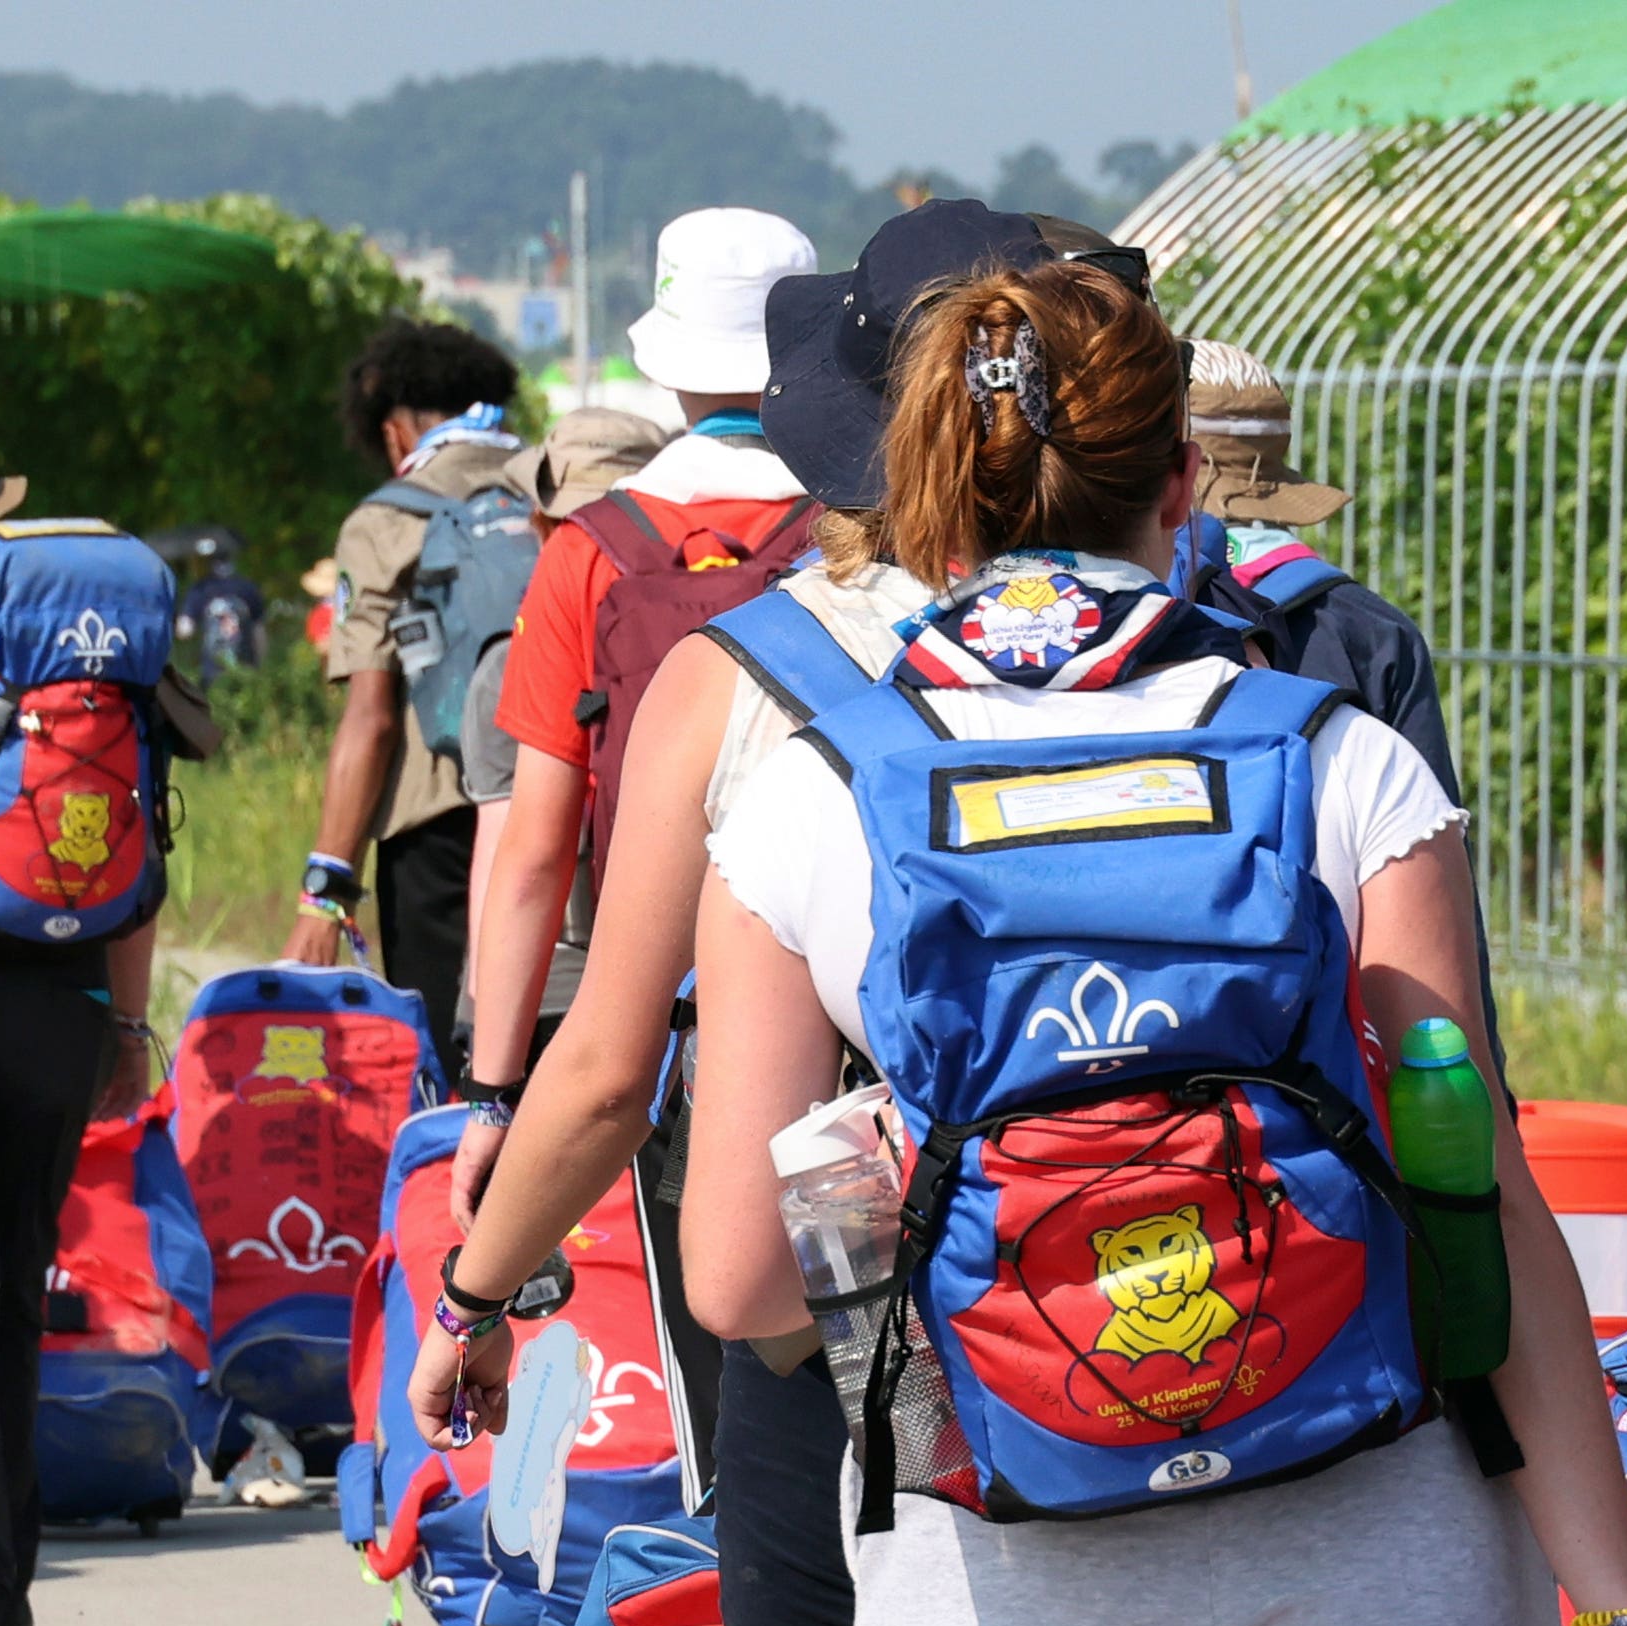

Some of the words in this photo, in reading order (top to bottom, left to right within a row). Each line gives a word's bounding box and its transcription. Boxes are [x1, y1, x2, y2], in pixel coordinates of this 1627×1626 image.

[1152, 1379, 1222, 1404] Kingdom
[1116, 1414, 1135, 1430] 25
[1170, 1397, 1210, 1415] Korea
[1166, 1452, 1212, 1482] GO
